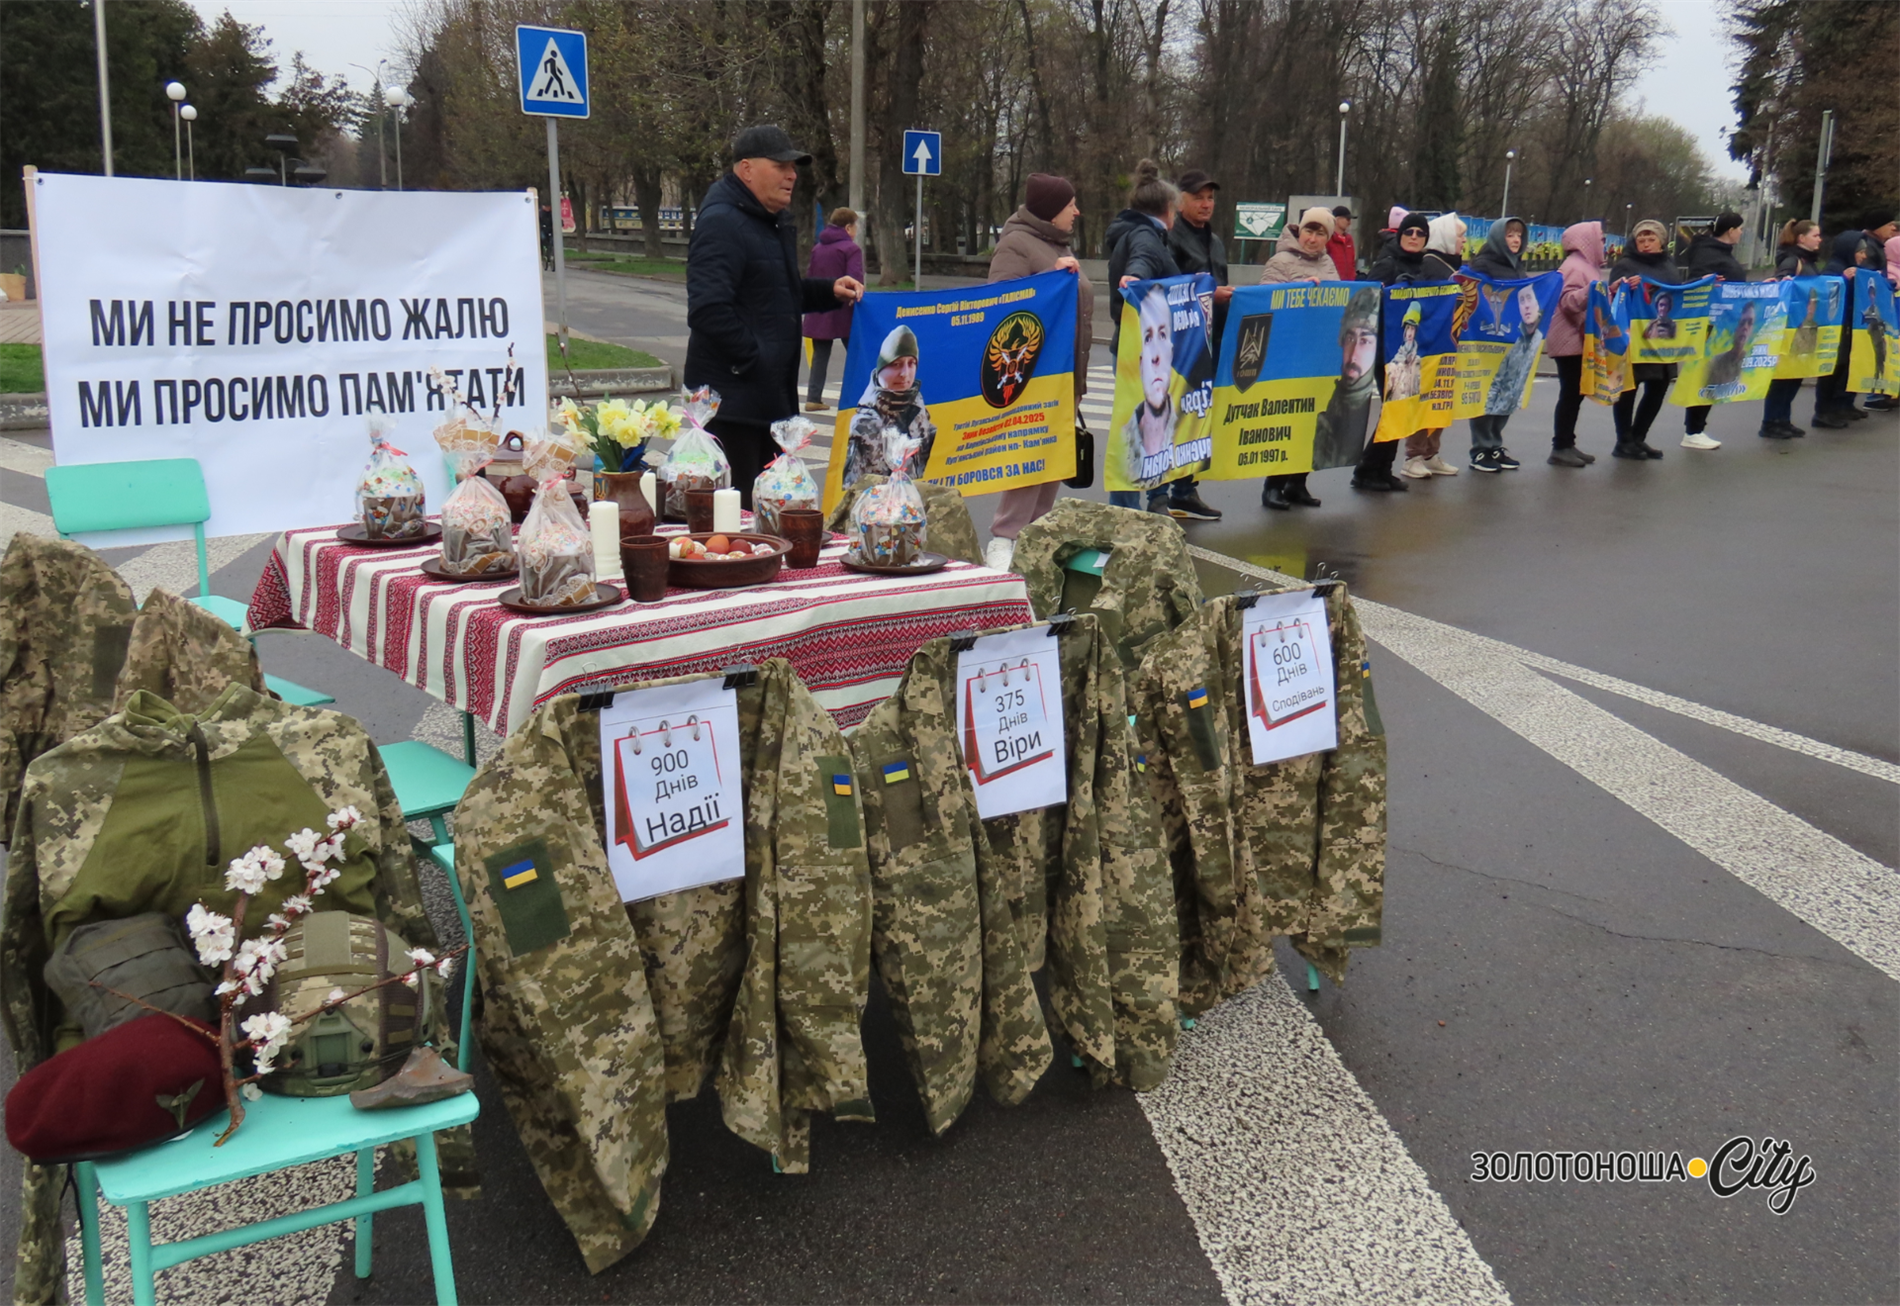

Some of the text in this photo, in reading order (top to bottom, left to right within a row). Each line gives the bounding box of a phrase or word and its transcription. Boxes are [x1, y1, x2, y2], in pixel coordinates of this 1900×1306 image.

[896, 305, 936, 319] Денисенко
[936, 301, 959, 314] Сергій
[1270, 287, 1350, 310] МИ ТЕБЕ ЧЕКАЄМО
[89, 297, 509, 346] МИ НЕ ПРОСИМО ЖАЛЮ
[951, 311, 985, 327] 05.11.1989
[78, 367, 525, 428] МИ ПРОСИМО ПАМ'ЯТАТИ
[1223, 397, 1316, 426] Дутчак Валентин
[1007, 425, 1049, 439] напрямку
[1238, 426, 1292, 446] Іванович
[957, 467, 1003, 486] БОРОВСЯ
[1005, 465, 1021, 478] ЗА
[1022, 458, 1046, 474] НАС!
[1273, 642, 1301, 666] 600
[1277, 662, 1307, 687] Днів
[995, 689, 1025, 713] 375
[1272, 686, 1325, 712] Сподівань
[998, 712, 1028, 735] Днів
[994, 731, 1042, 764] Віри
[651, 749, 689, 776] 900
[655, 774, 699, 804] Днів
[646, 793, 720, 843] Надії
